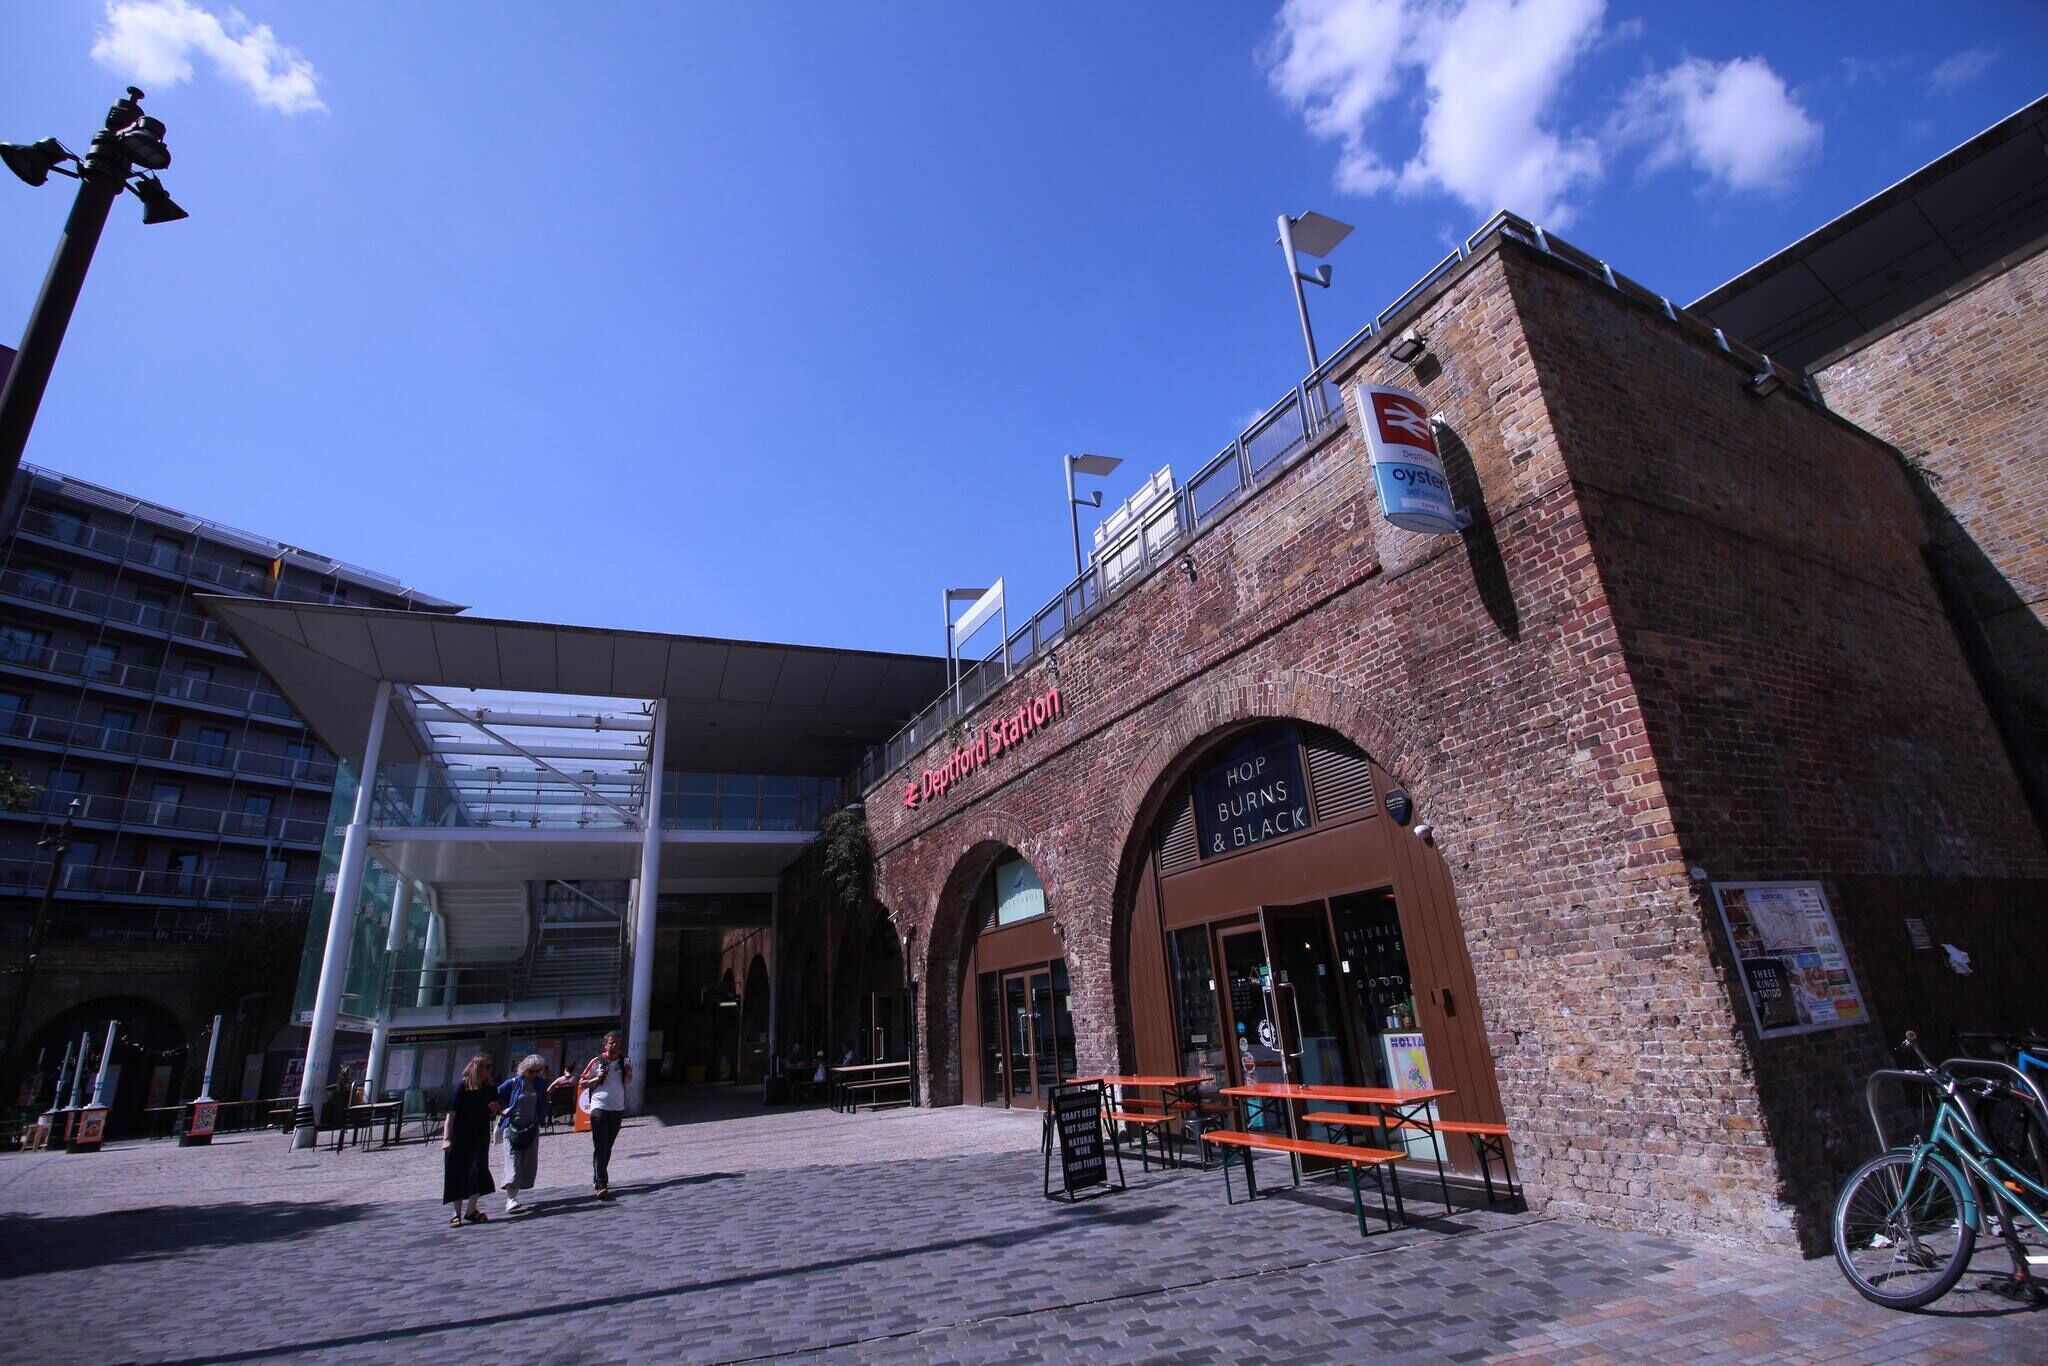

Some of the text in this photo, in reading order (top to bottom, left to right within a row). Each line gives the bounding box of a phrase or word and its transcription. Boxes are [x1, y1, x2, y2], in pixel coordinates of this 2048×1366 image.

[1393, 469, 1444, 490] oyster
[922, 688, 1060, 798] Deptford Station
[1227, 756, 1266, 787] HOP
[1218, 781, 1288, 822] BURNS
[1213, 806, 1307, 853] & BLACK
[1344, 924, 1399, 942] NATURAL
[1347, 941, 1401, 956] WINE
[1752, 968, 1777, 978] THREE
[1357, 976, 1404, 989] GOOD
[1756, 978, 1780, 988] KINGS
[1758, 988, 1782, 999] TATTOO
[1061, 1107, 1097, 1121] CRAFT BEER
[1064, 1121, 1097, 1135] HOT SAUCE
[1068, 1135, 1096, 1147] NATURAL
[1075, 1146, 1091, 1156] WINE
[1083, 1157, 1102, 1168] TIMES
